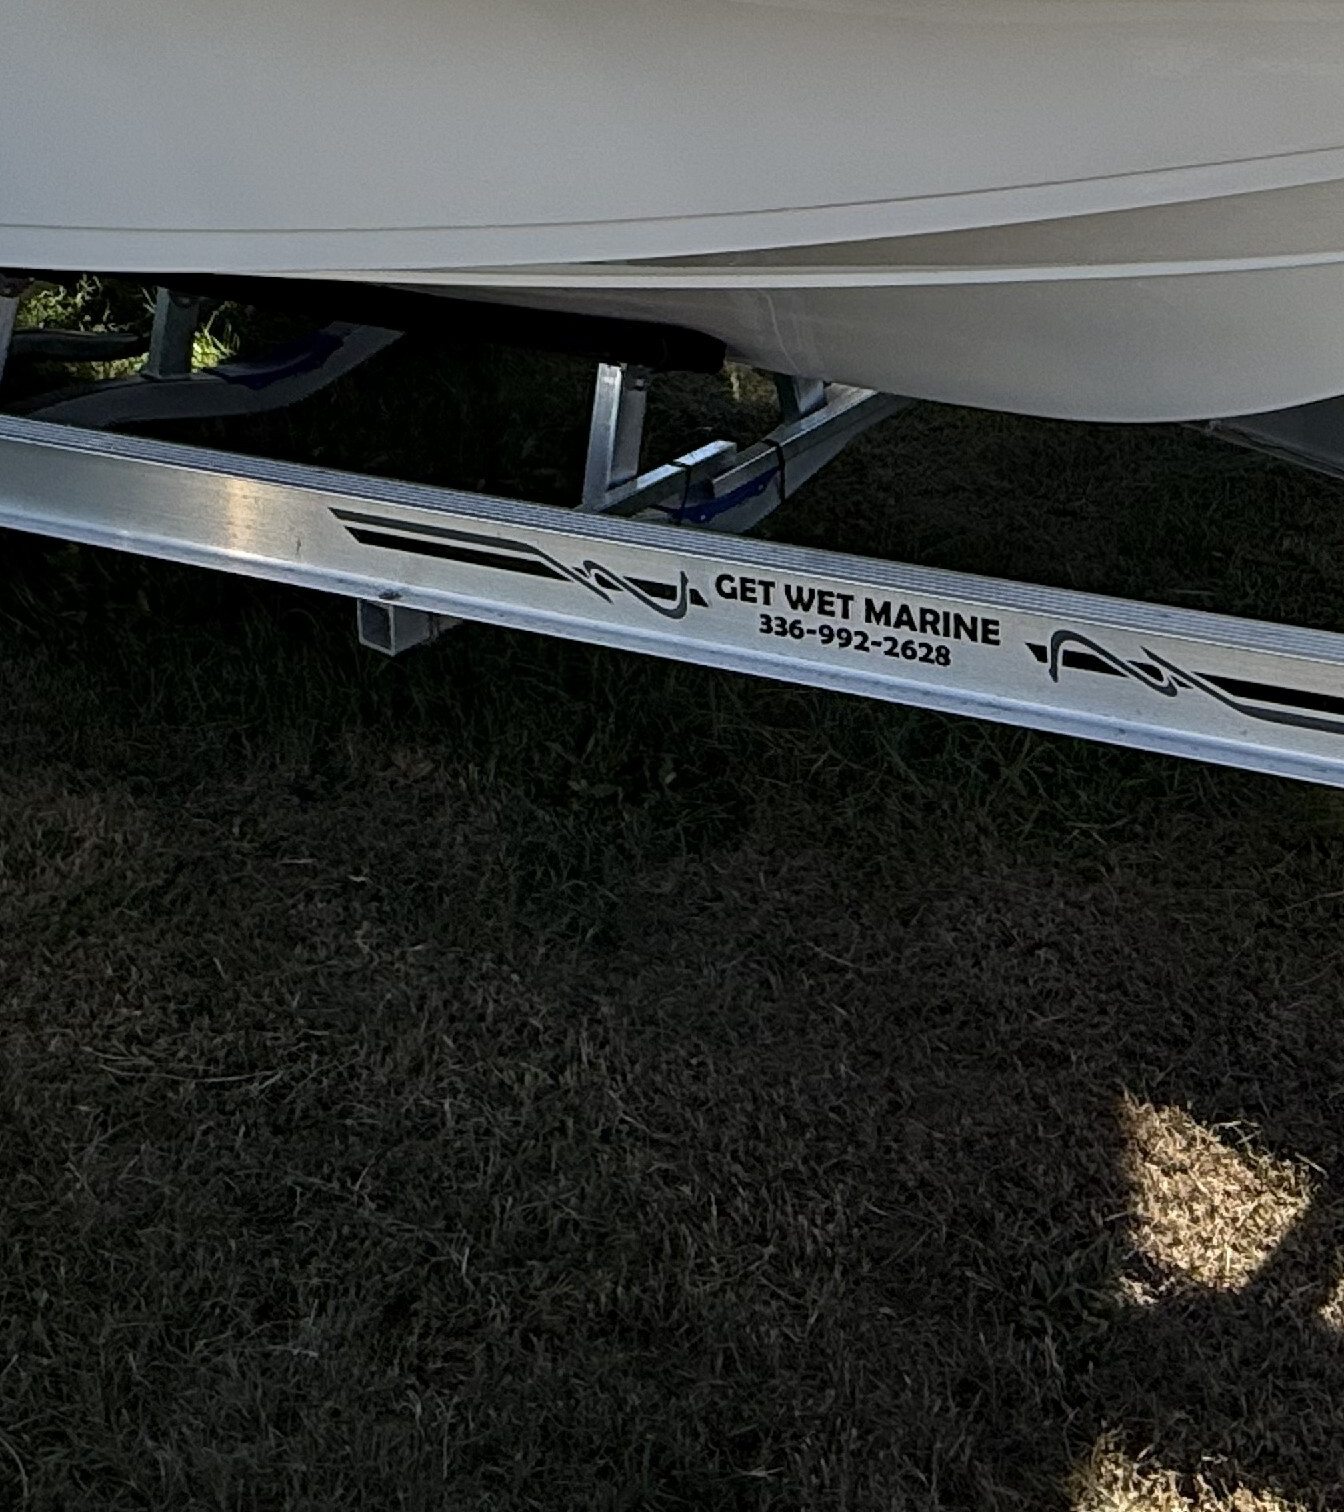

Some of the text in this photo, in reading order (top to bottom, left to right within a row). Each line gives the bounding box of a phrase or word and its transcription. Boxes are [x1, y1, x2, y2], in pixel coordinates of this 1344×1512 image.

[714, 573, 1002, 646] GET WET MARINE
[758, 613, 952, 667] 336-992-2628
